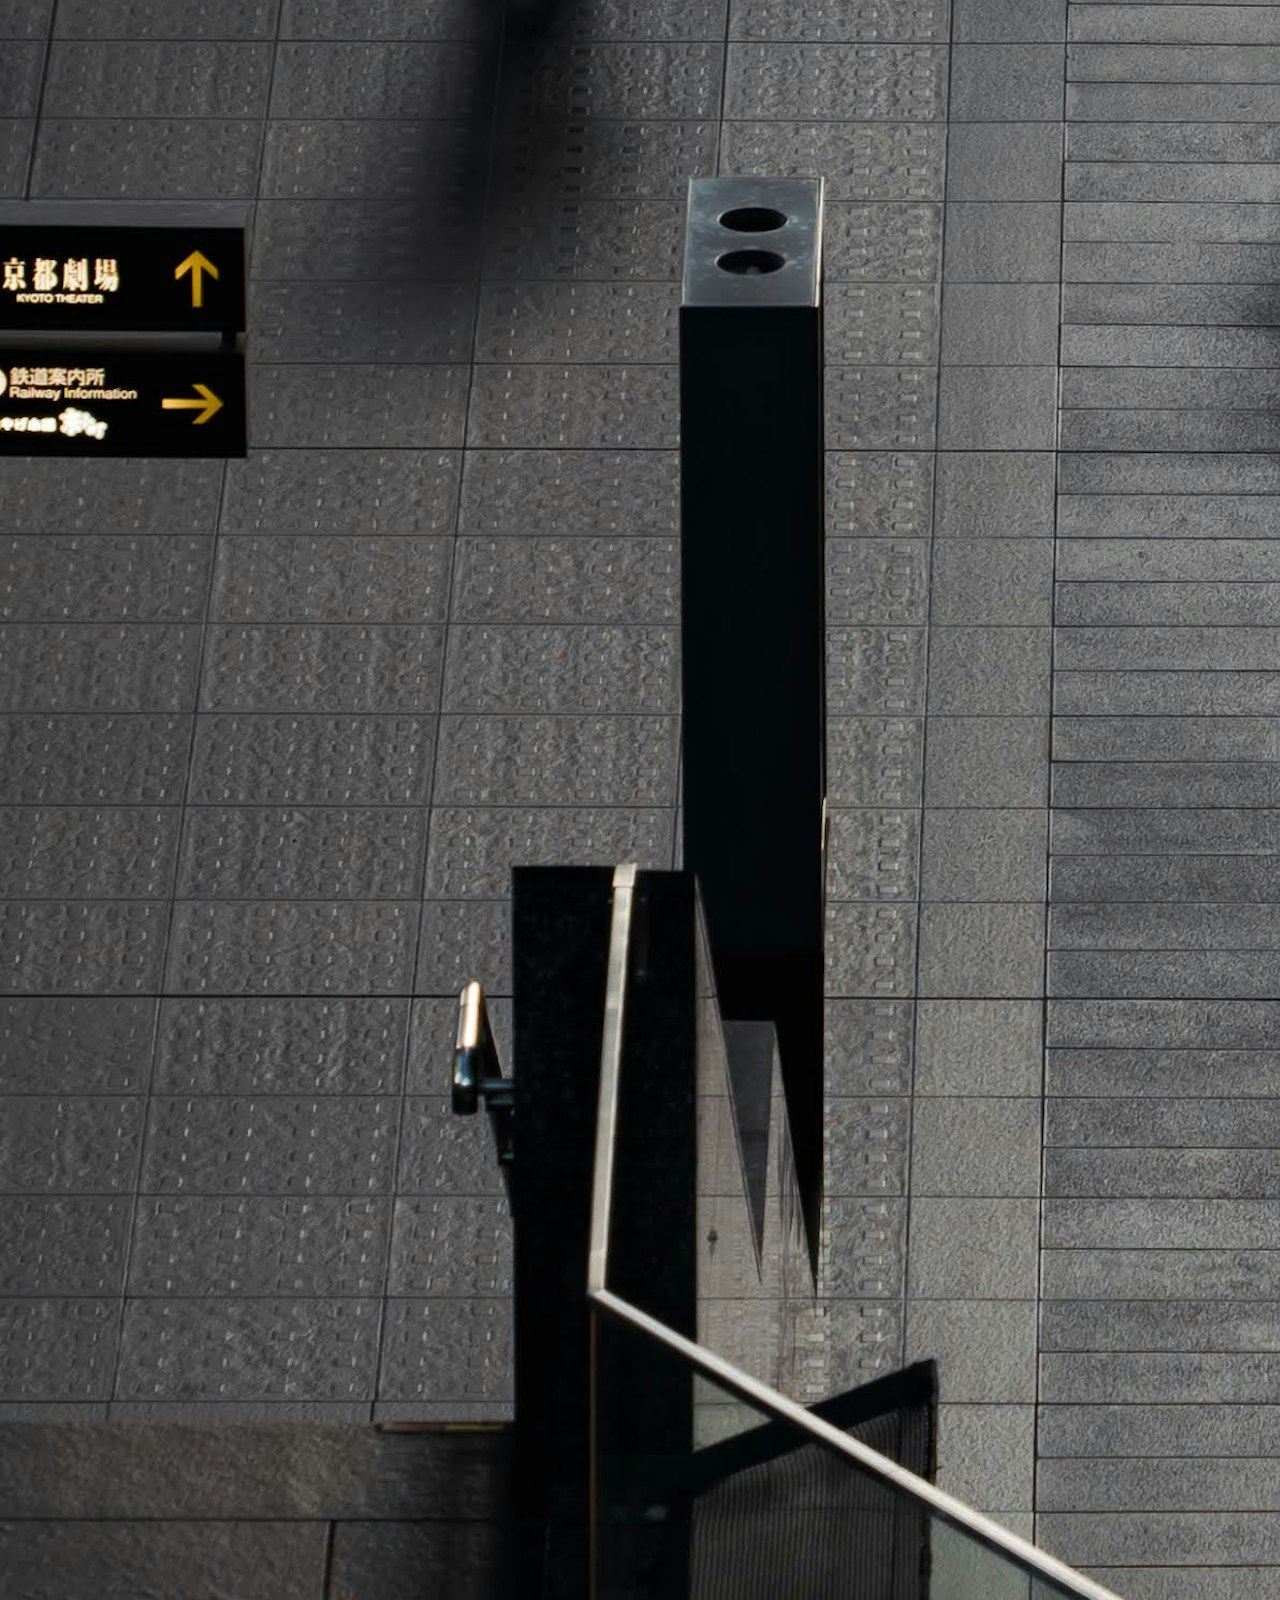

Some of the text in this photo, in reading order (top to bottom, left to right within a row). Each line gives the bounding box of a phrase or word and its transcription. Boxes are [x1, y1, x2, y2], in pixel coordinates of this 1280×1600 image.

[2, 257, 119, 292] 京都劇場
[16, 293, 104, 304] KYOTO THEATER
[10, 367, 105, 386] 鉄道案内所
[9, 386, 137, 401] Railway Information
